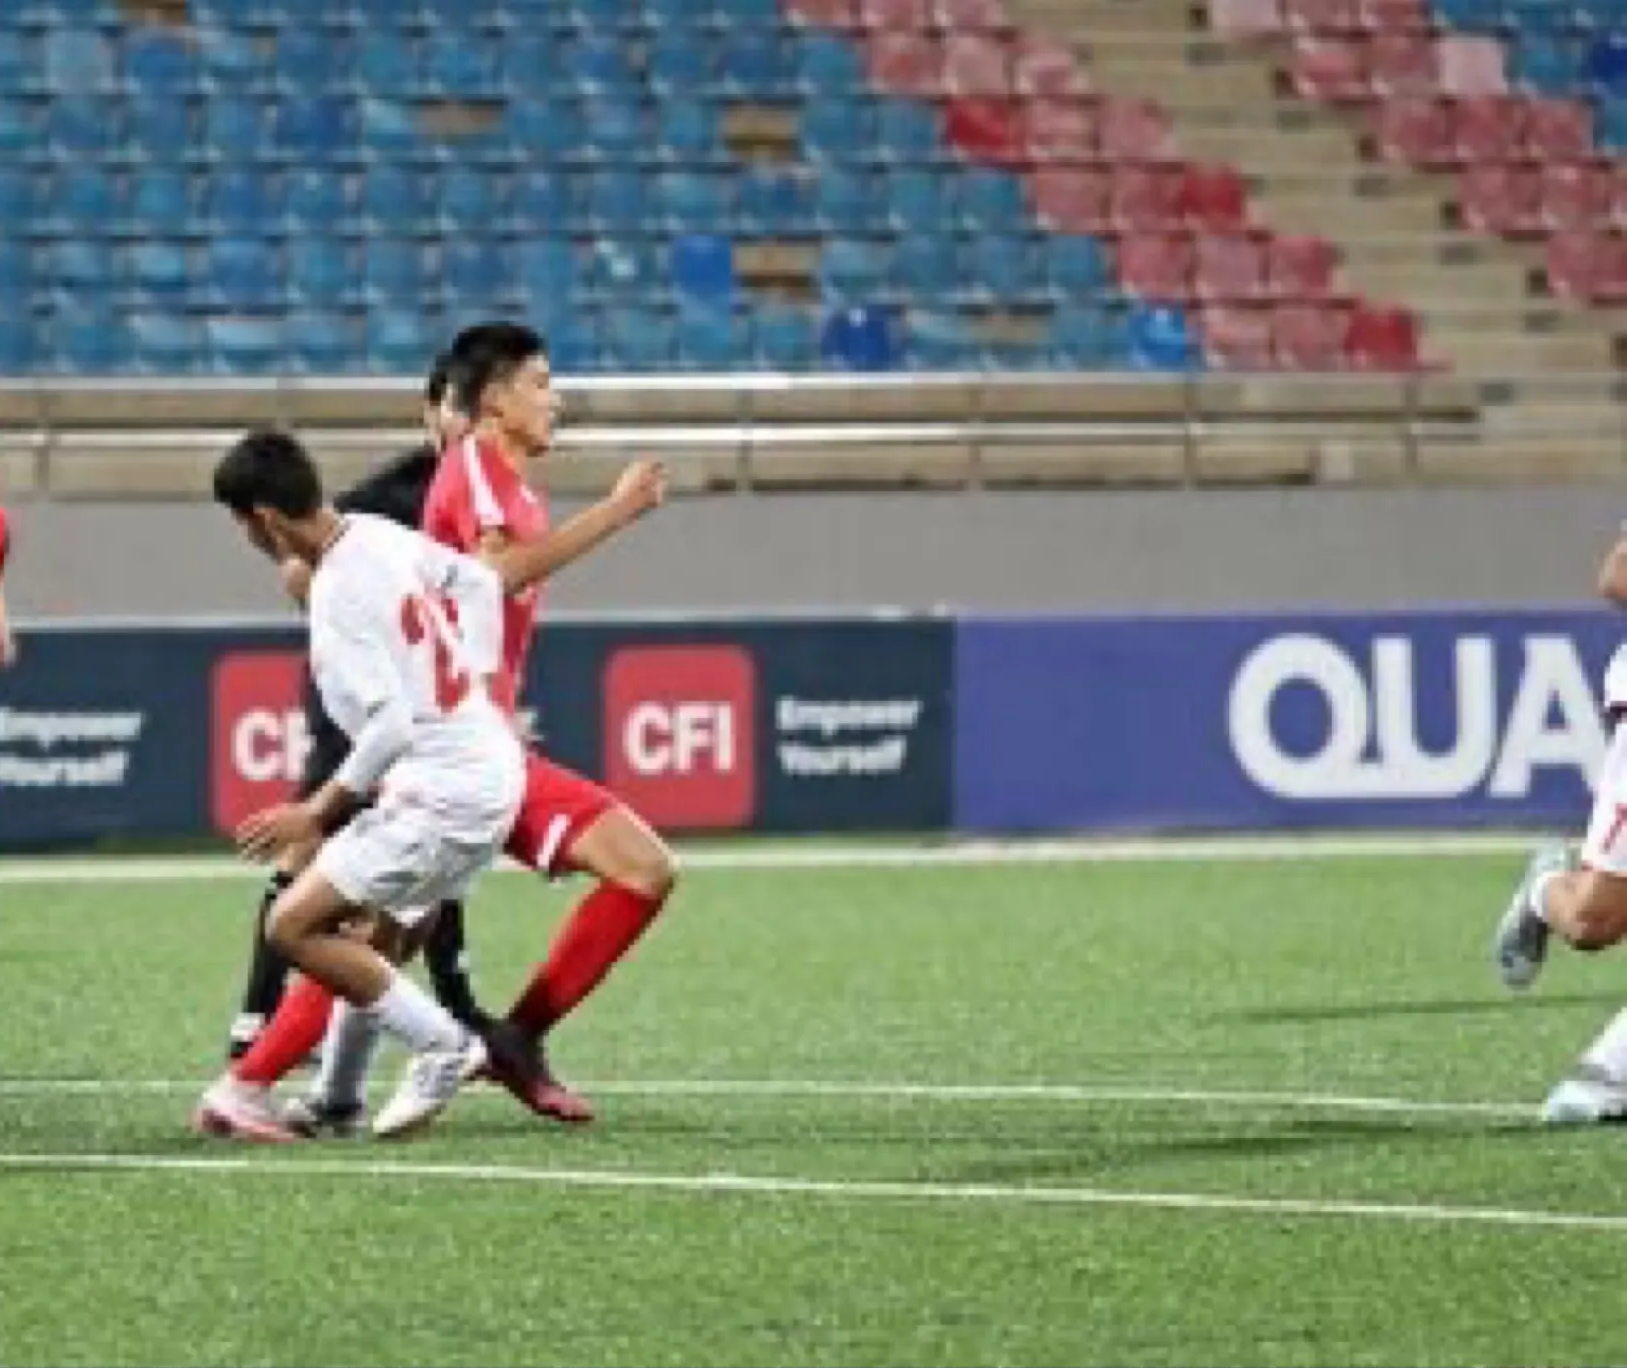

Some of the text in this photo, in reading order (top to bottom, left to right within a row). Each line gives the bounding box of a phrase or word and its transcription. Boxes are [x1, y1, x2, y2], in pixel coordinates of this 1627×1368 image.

[622, 701, 734, 774] CFI
[777, 695, 924, 738] Empower
[777, 736, 907, 775] Yourself
